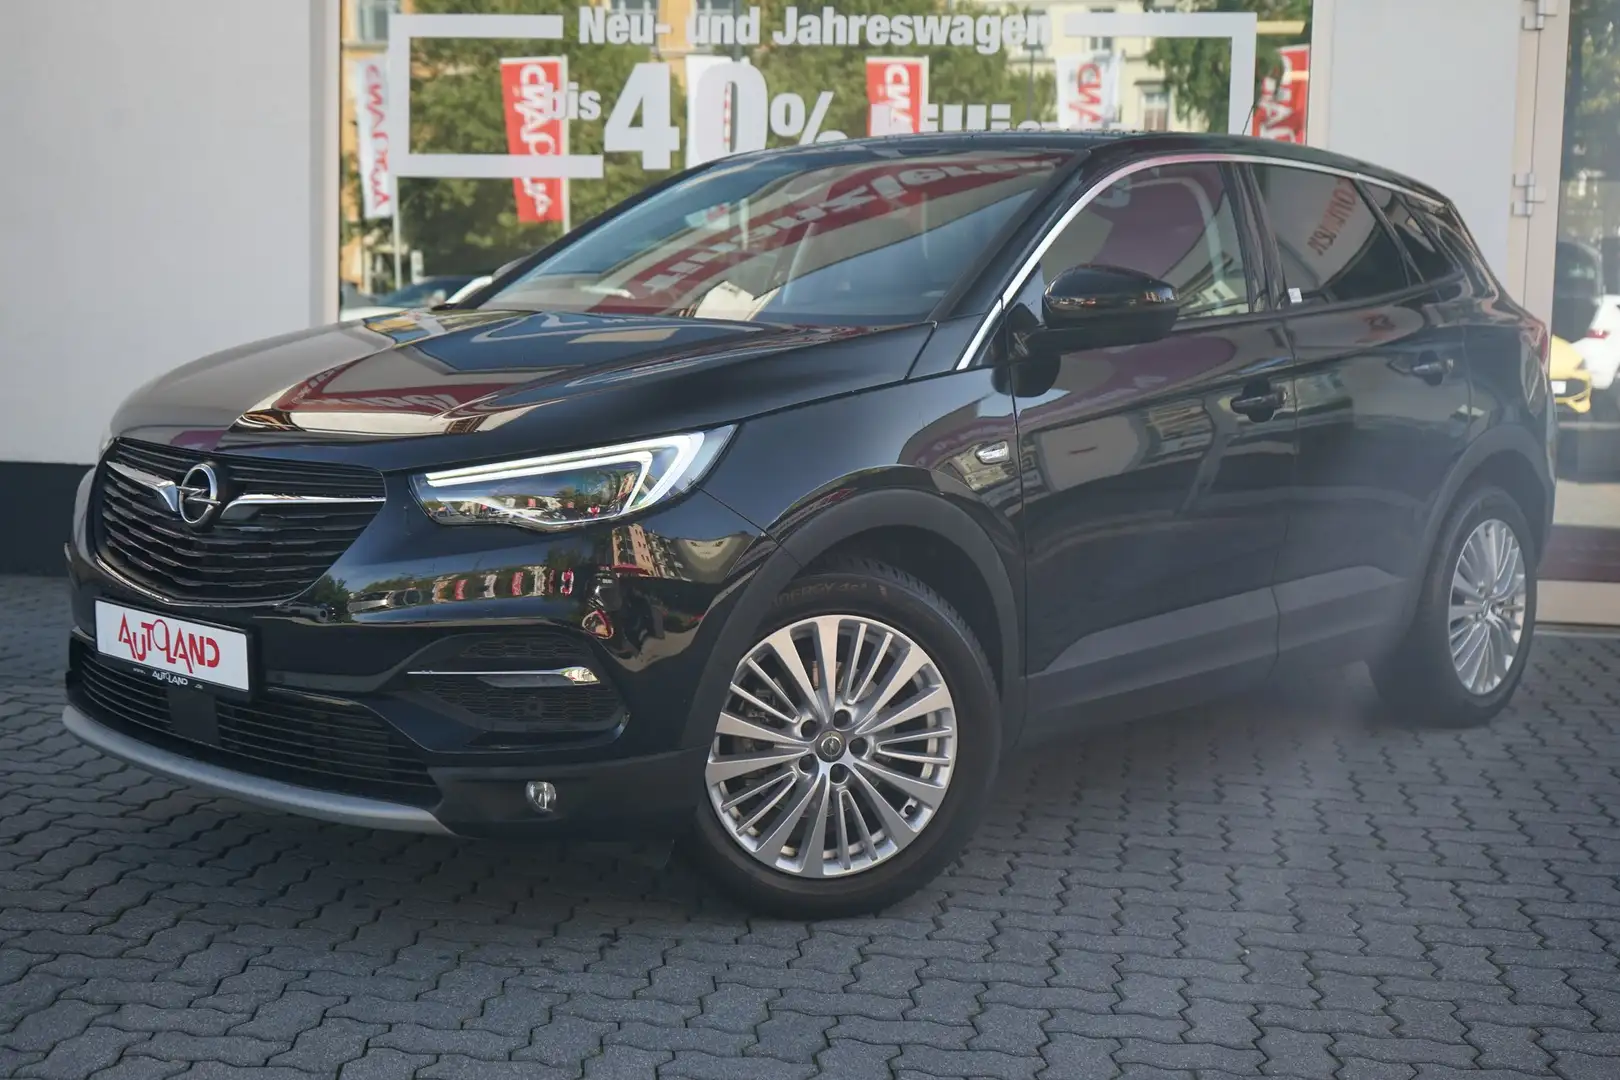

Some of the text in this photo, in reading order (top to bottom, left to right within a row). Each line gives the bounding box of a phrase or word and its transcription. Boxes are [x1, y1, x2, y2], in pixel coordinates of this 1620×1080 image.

[578, 6, 1052, 54] Neu- und Jahreswagen
[543, 82, 601, 120] bis
[604, 62, 848, 170] 40%
[118, 613, 220, 674] AUTOLAND
[152, 671, 188, 686] AUTOLAND
